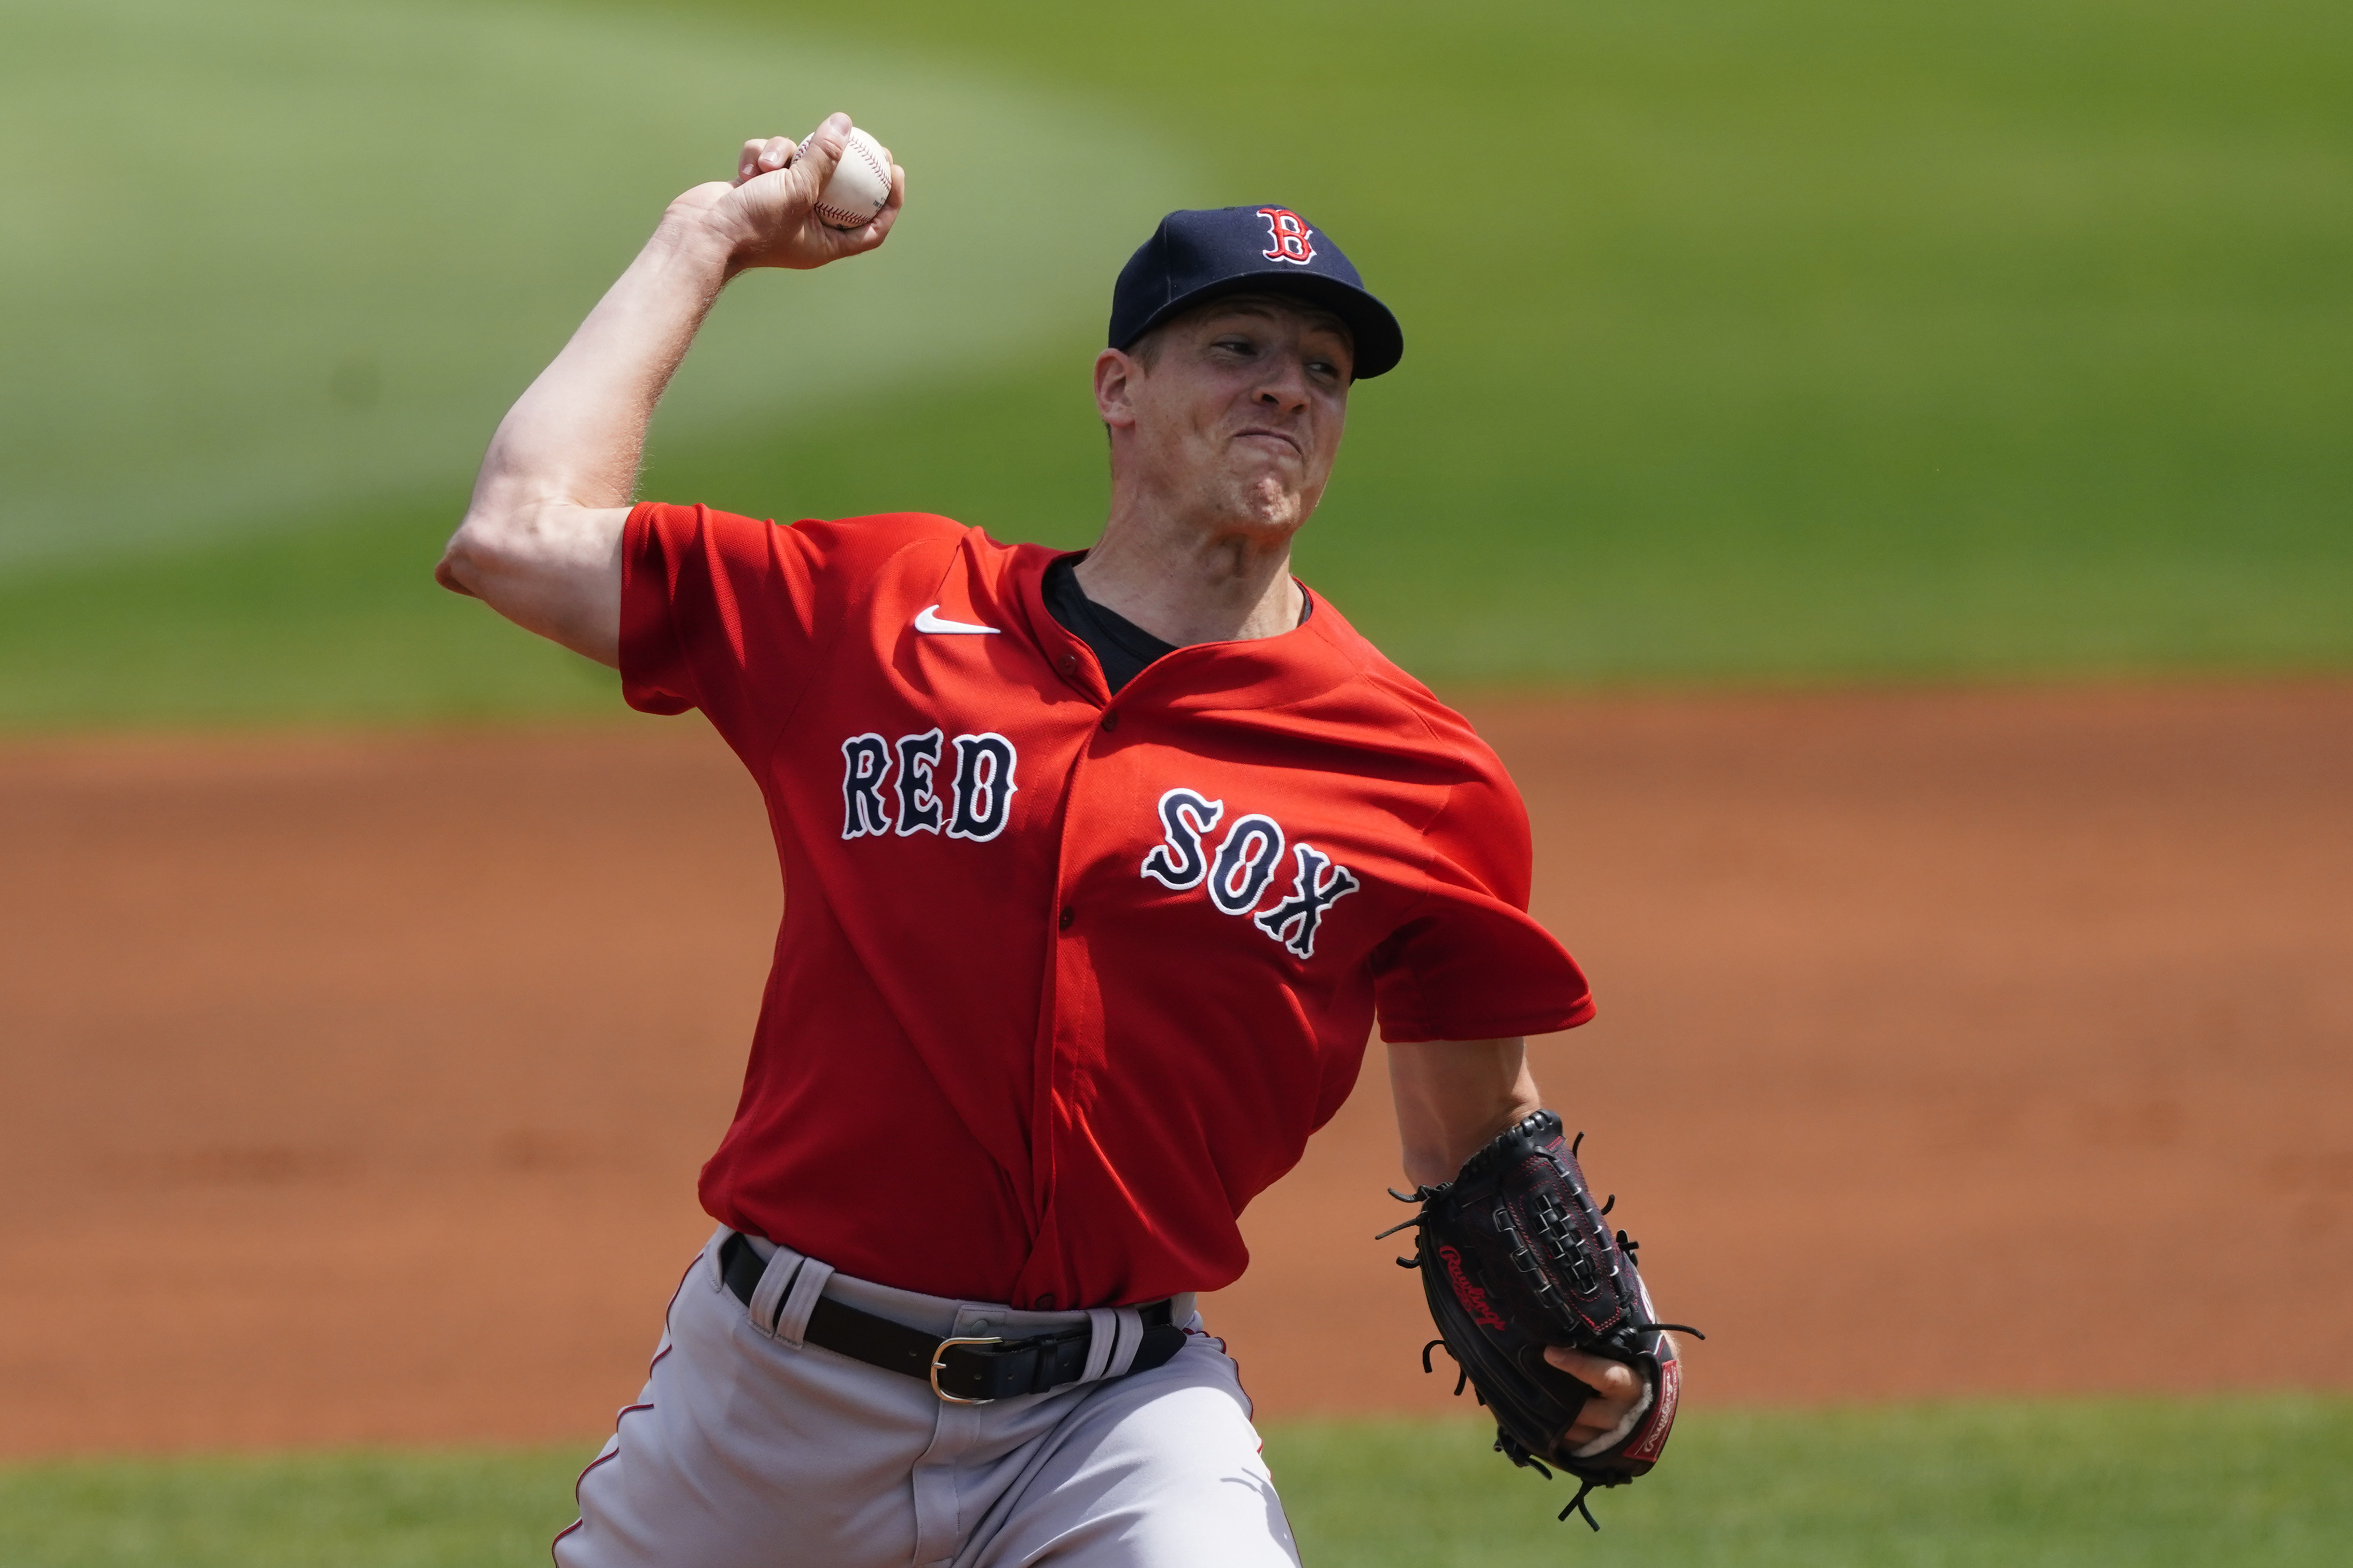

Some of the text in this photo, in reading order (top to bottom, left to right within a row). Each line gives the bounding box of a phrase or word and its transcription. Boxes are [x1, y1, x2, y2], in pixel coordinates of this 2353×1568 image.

[1256, 208, 1317, 265] B
[841, 727, 1360, 959] RED SOX
[1439, 1246, 1506, 1331] Rawlings
